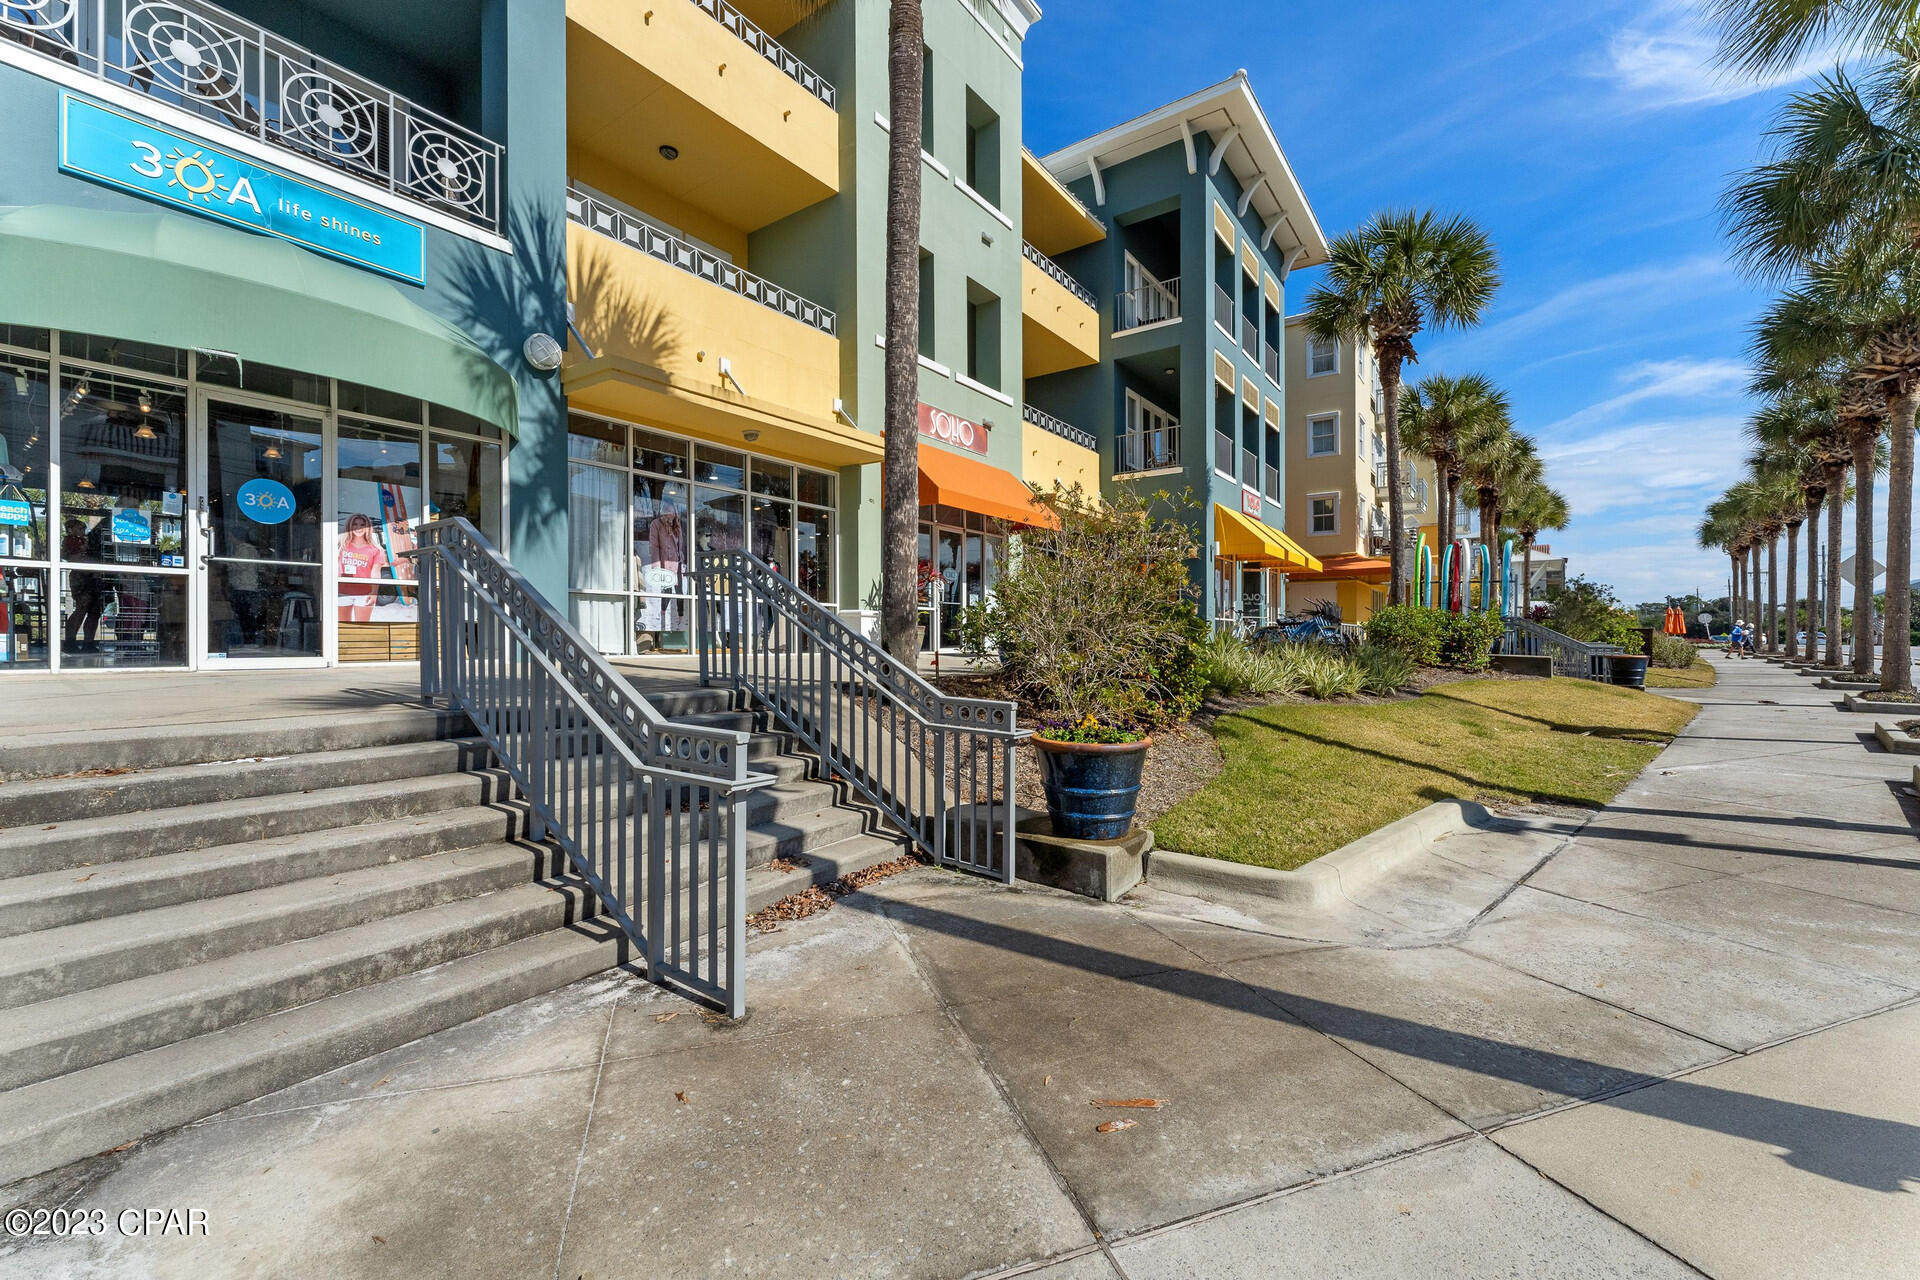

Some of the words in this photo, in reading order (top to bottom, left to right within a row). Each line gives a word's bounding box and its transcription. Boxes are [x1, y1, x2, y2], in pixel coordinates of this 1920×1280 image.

[129, 140, 262, 214] 30A
[279, 198, 312, 221] life
[321, 216, 382, 245] shines
[930, 409, 974, 446] SOHO
[244, 491, 290, 510] 30A
[341, 558, 368, 568] happy
